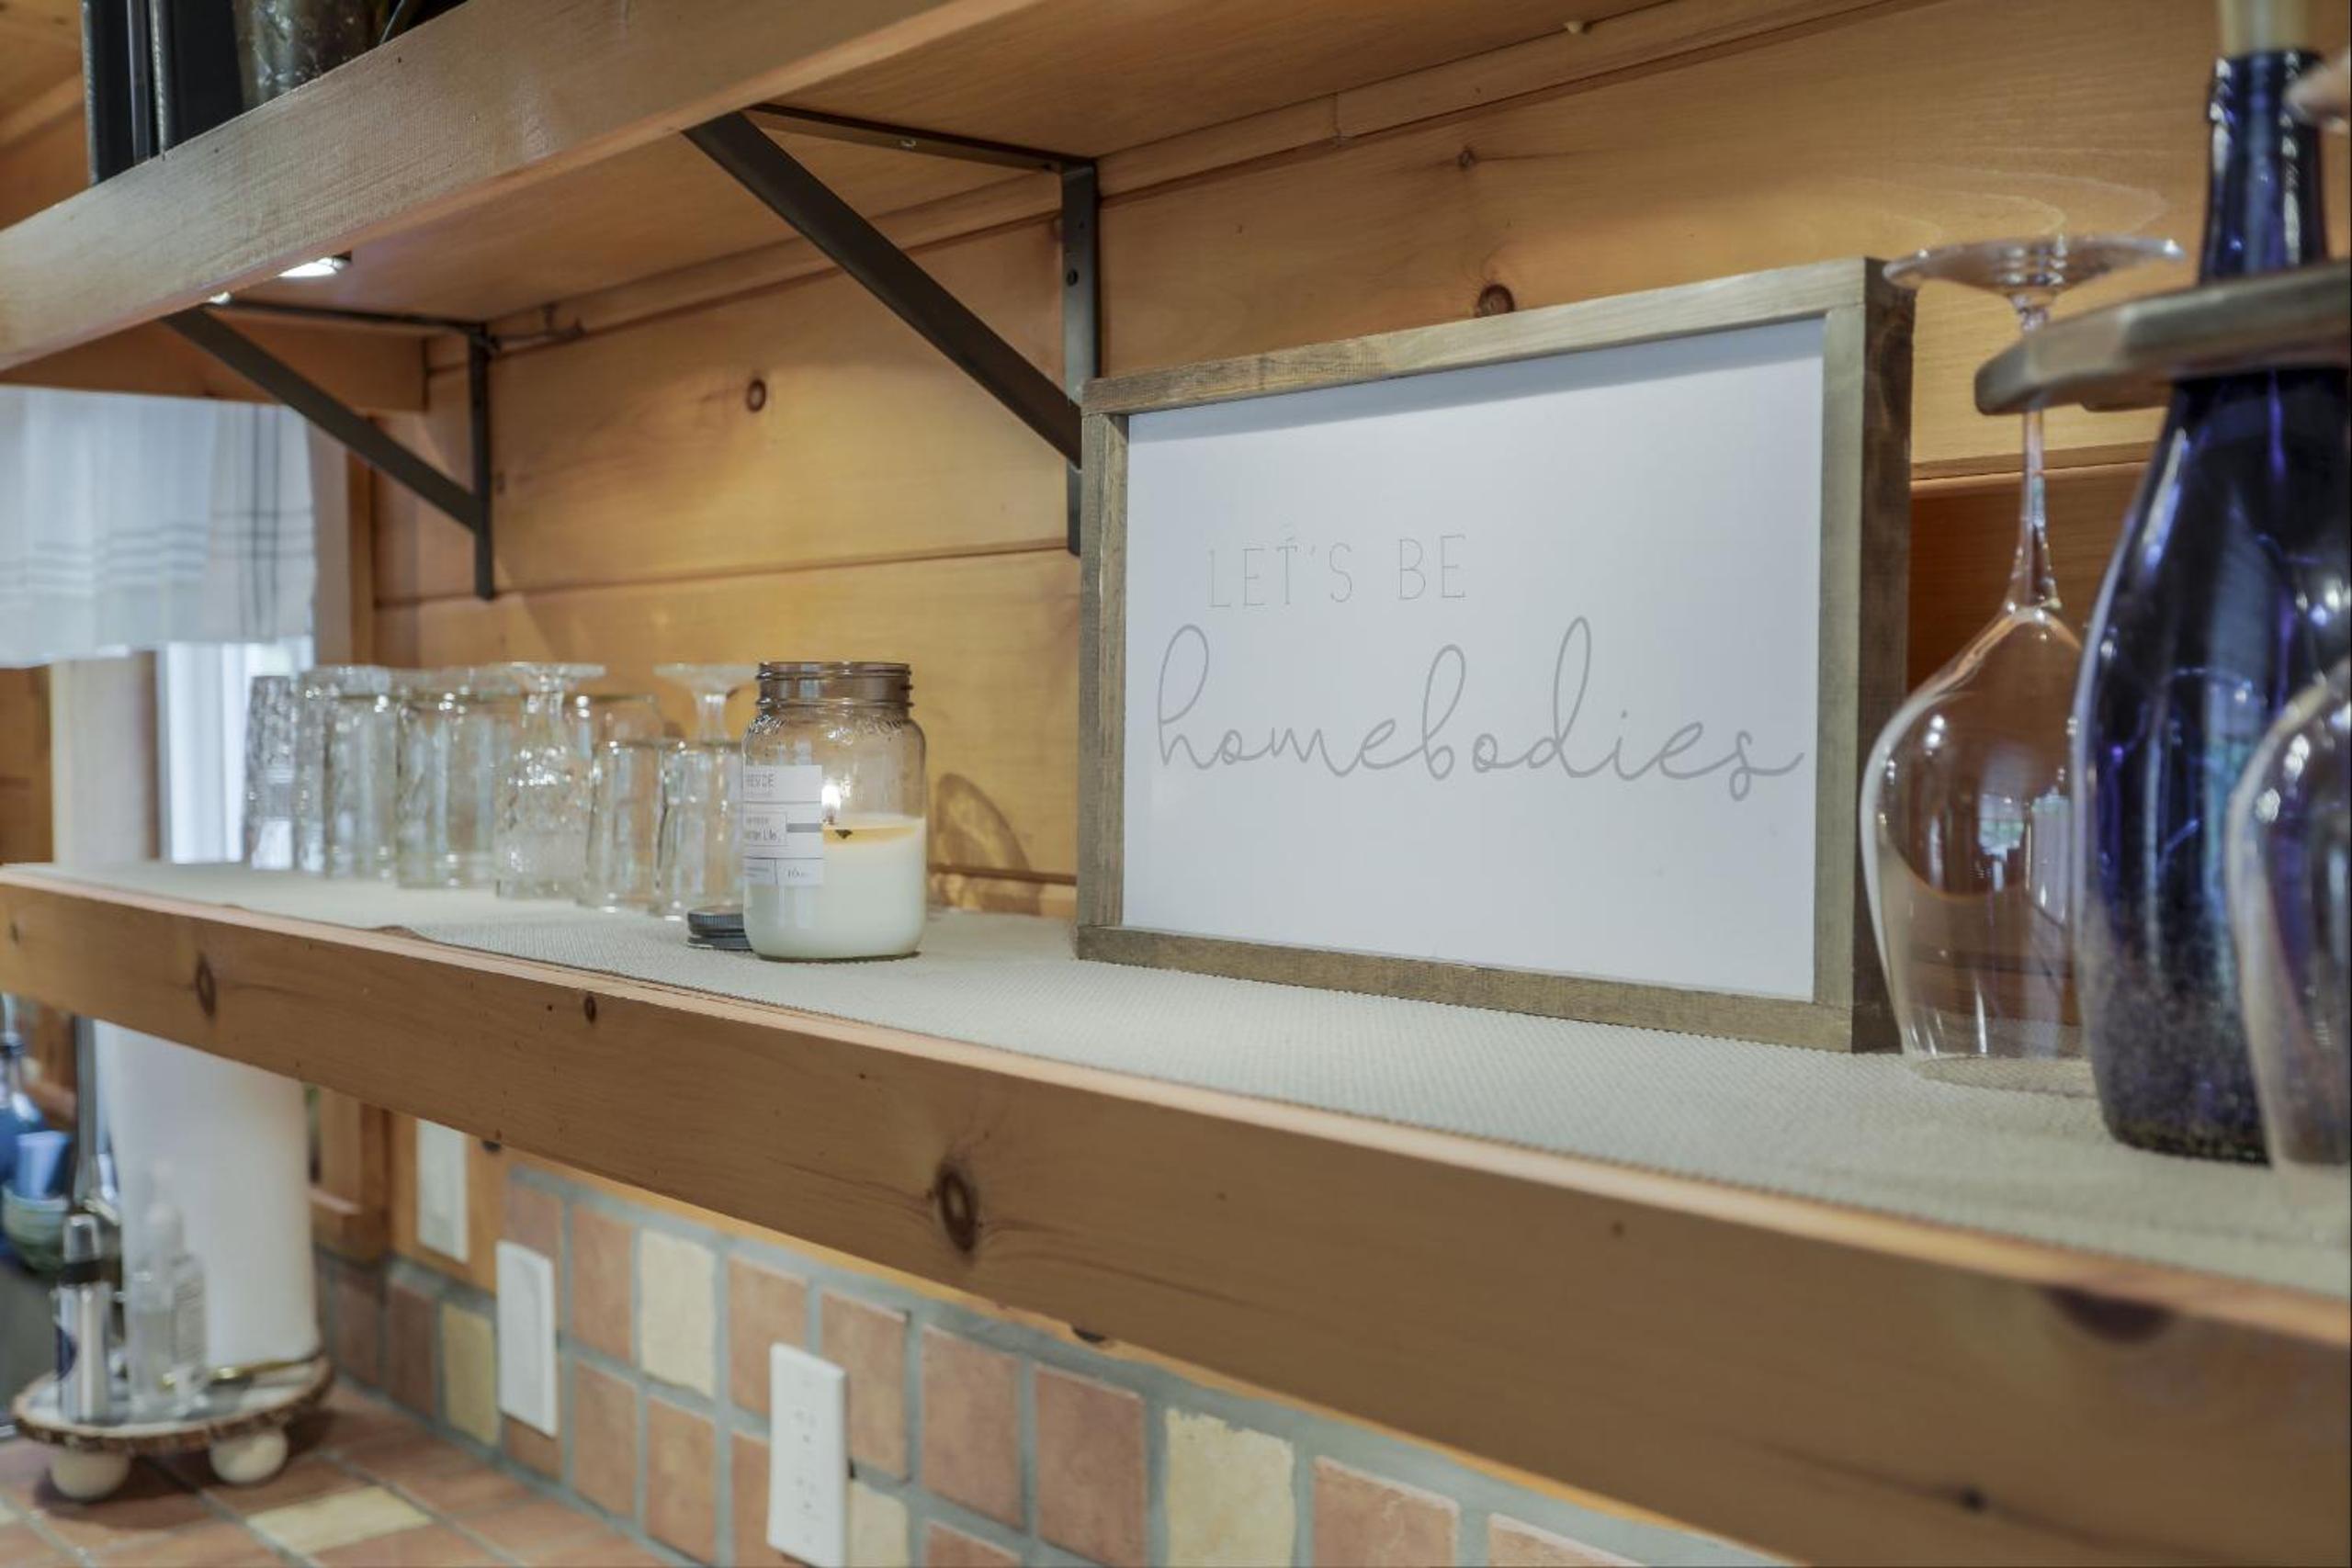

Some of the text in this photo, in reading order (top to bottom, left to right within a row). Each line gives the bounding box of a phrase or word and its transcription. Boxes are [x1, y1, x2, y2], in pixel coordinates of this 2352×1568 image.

[1209, 534, 1466, 608] LET'S BE
[1157, 615, 1804, 802] homebodies
